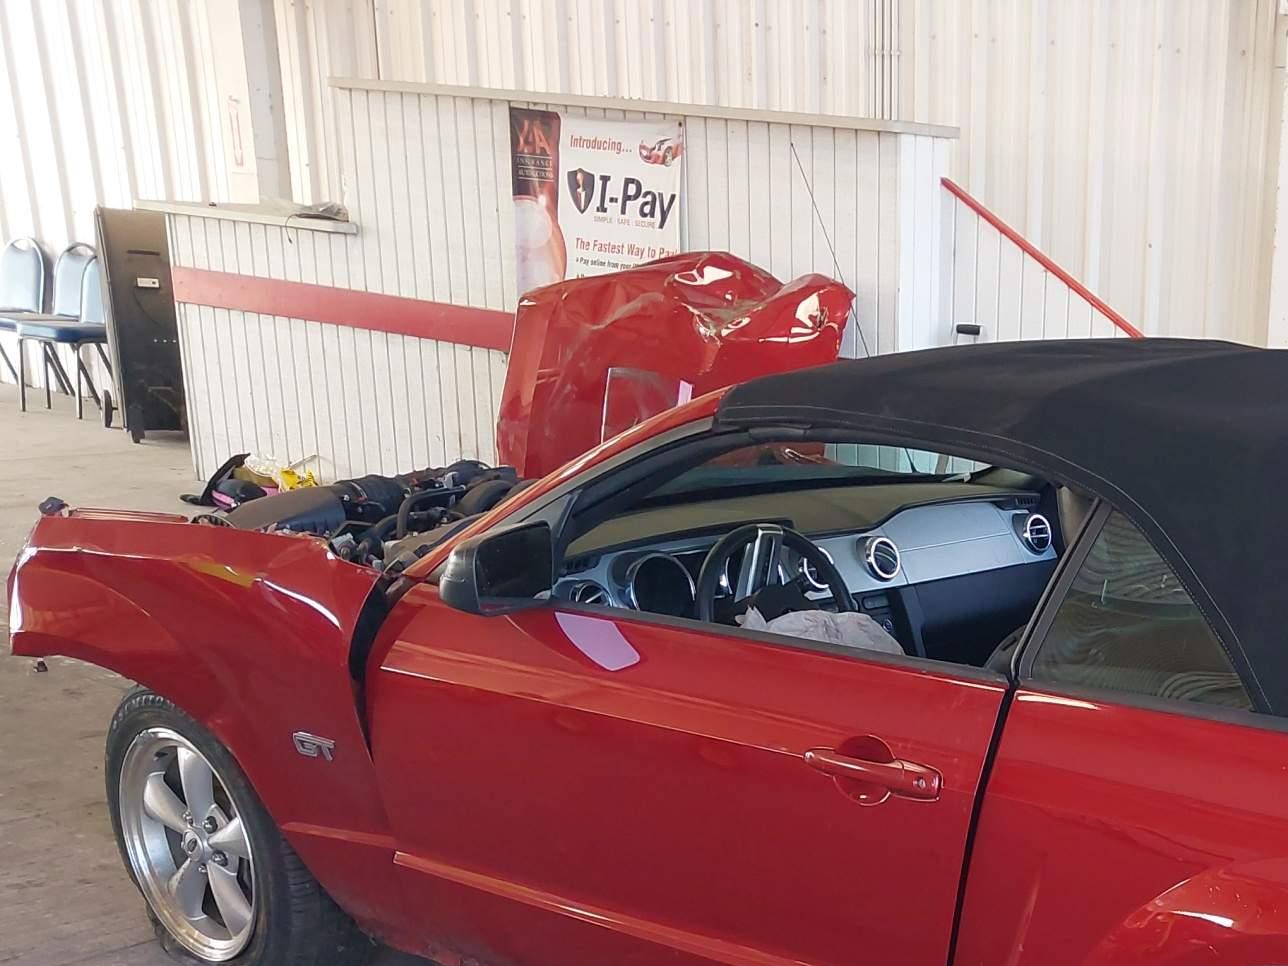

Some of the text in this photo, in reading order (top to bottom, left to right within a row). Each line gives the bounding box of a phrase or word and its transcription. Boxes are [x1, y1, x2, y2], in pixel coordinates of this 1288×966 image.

[570, 134, 632, 154] Introducing...
[596, 175, 676, 229] I-Pay
[576, 237, 590, 251] The
[593, 239, 625, 255] Fastest
[627, 243, 645, 259] Way
[648, 246, 656, 258] to
[293, 731, 335, 761] GT
